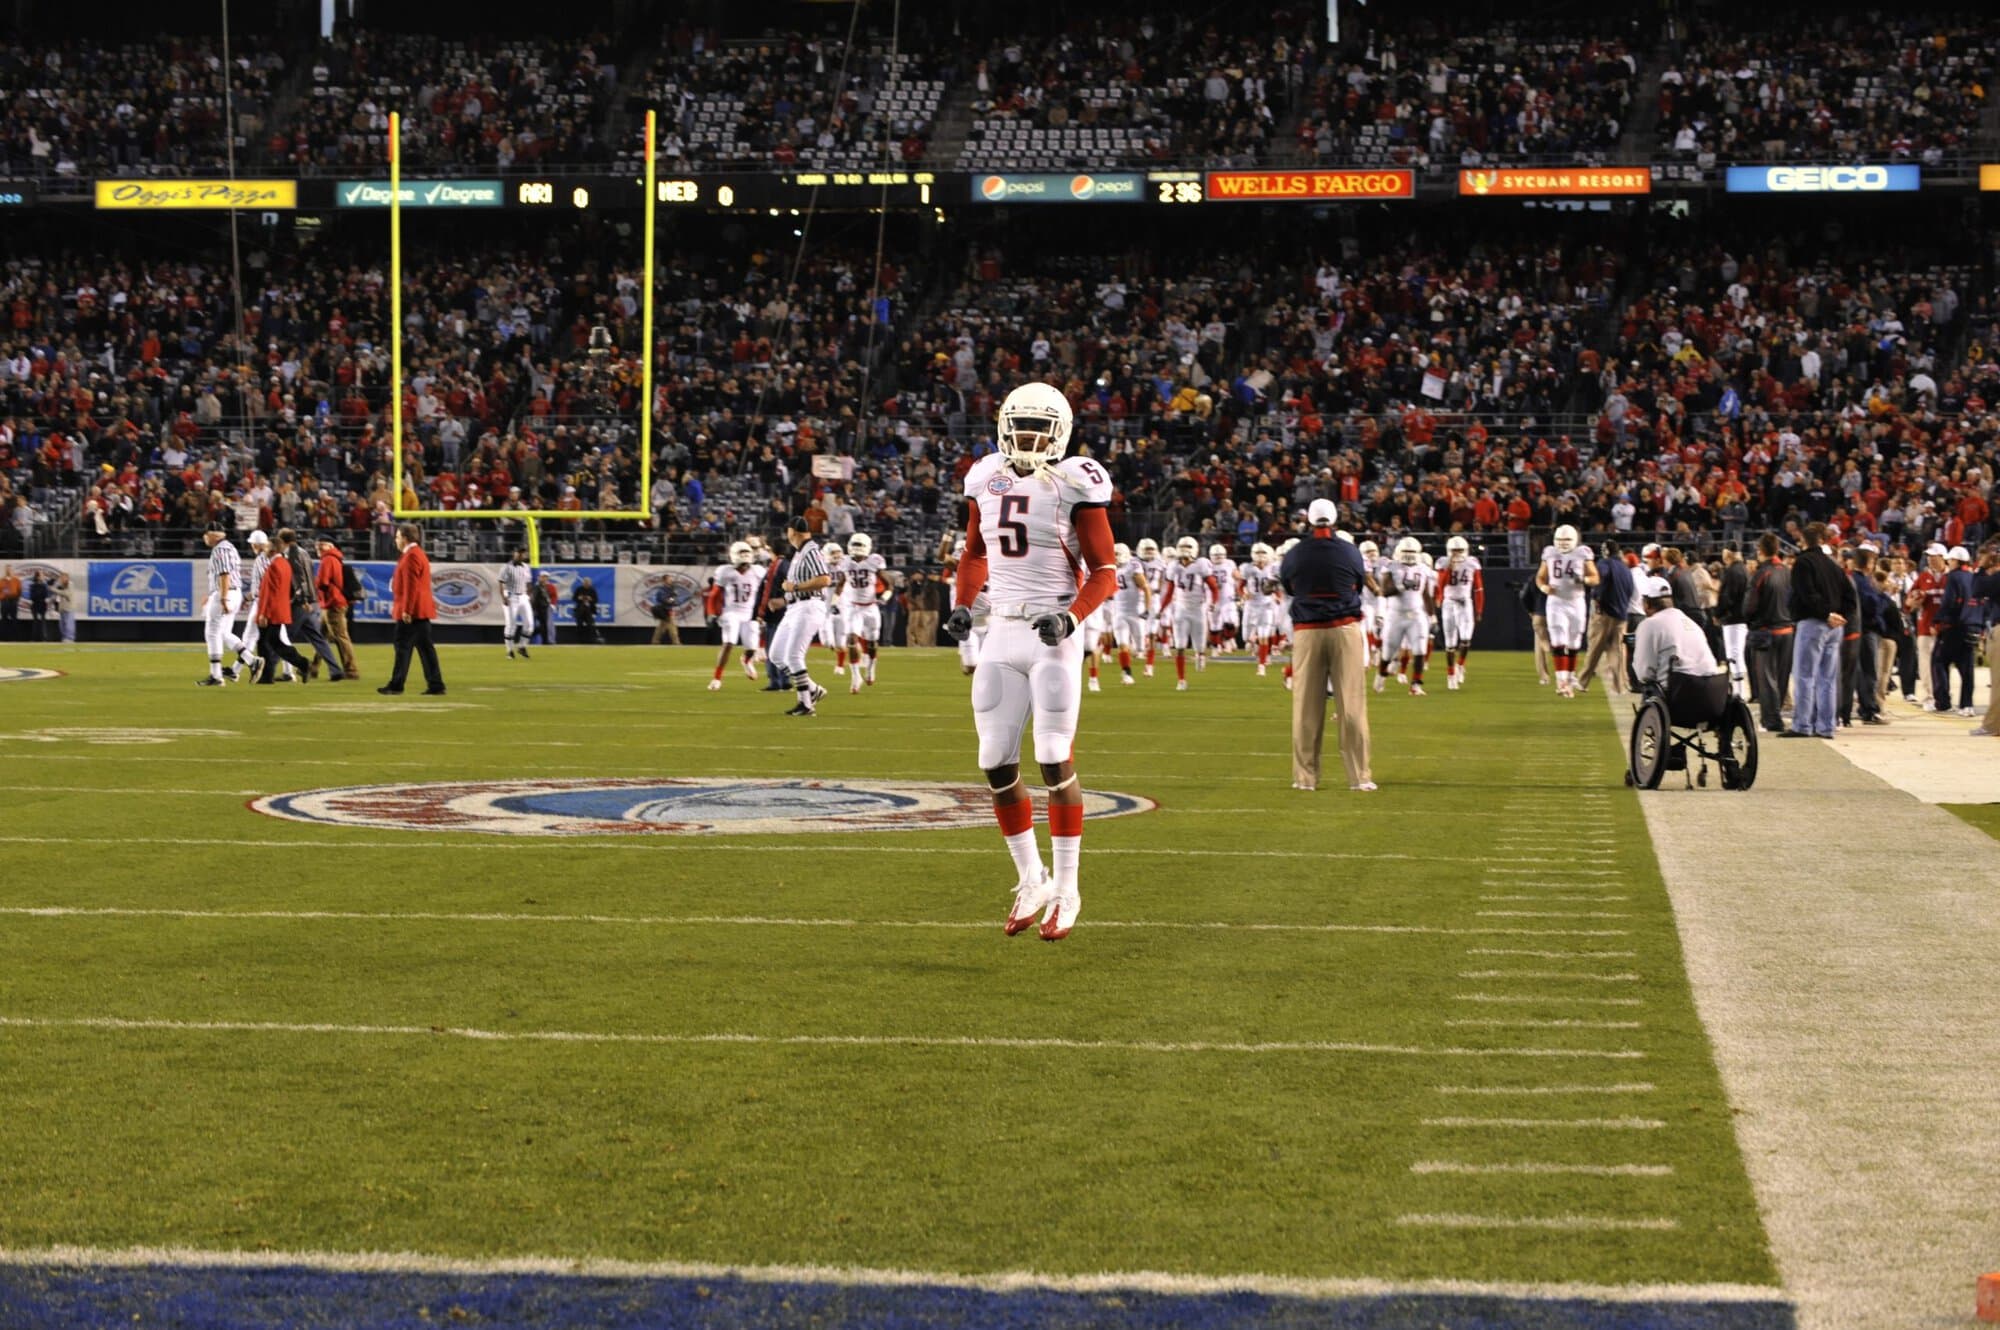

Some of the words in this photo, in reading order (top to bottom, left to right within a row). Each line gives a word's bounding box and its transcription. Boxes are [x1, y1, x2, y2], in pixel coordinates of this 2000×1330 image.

[1007, 180, 1045, 195] pepsi
[1095, 180, 1133, 193] pepsi
[1216, 176, 1308, 195] WELLS
[1313, 174, 1401, 194] FARGO
[1503, 175, 1571, 188] SYCUAN
[1579, 174, 1645, 188] RESORT
[1766, 166, 1888, 191] GEICO
[197, 184, 276, 204] Pizza
[440, 186, 495, 204] Degree
[519, 182, 553, 203] ARI
[573, 187, 589, 208] 0
[718, 186, 734, 207] 0
[1079, 462, 1104, 485] 5
[998, 495, 1030, 558] 5
[848, 569, 869, 588] 32
[1450, 569, 1469, 587] 84
[1553, 559, 1574, 579] 64
[91, 596, 153, 614] PACIFIC
[154, 596, 189, 614] LIFE
